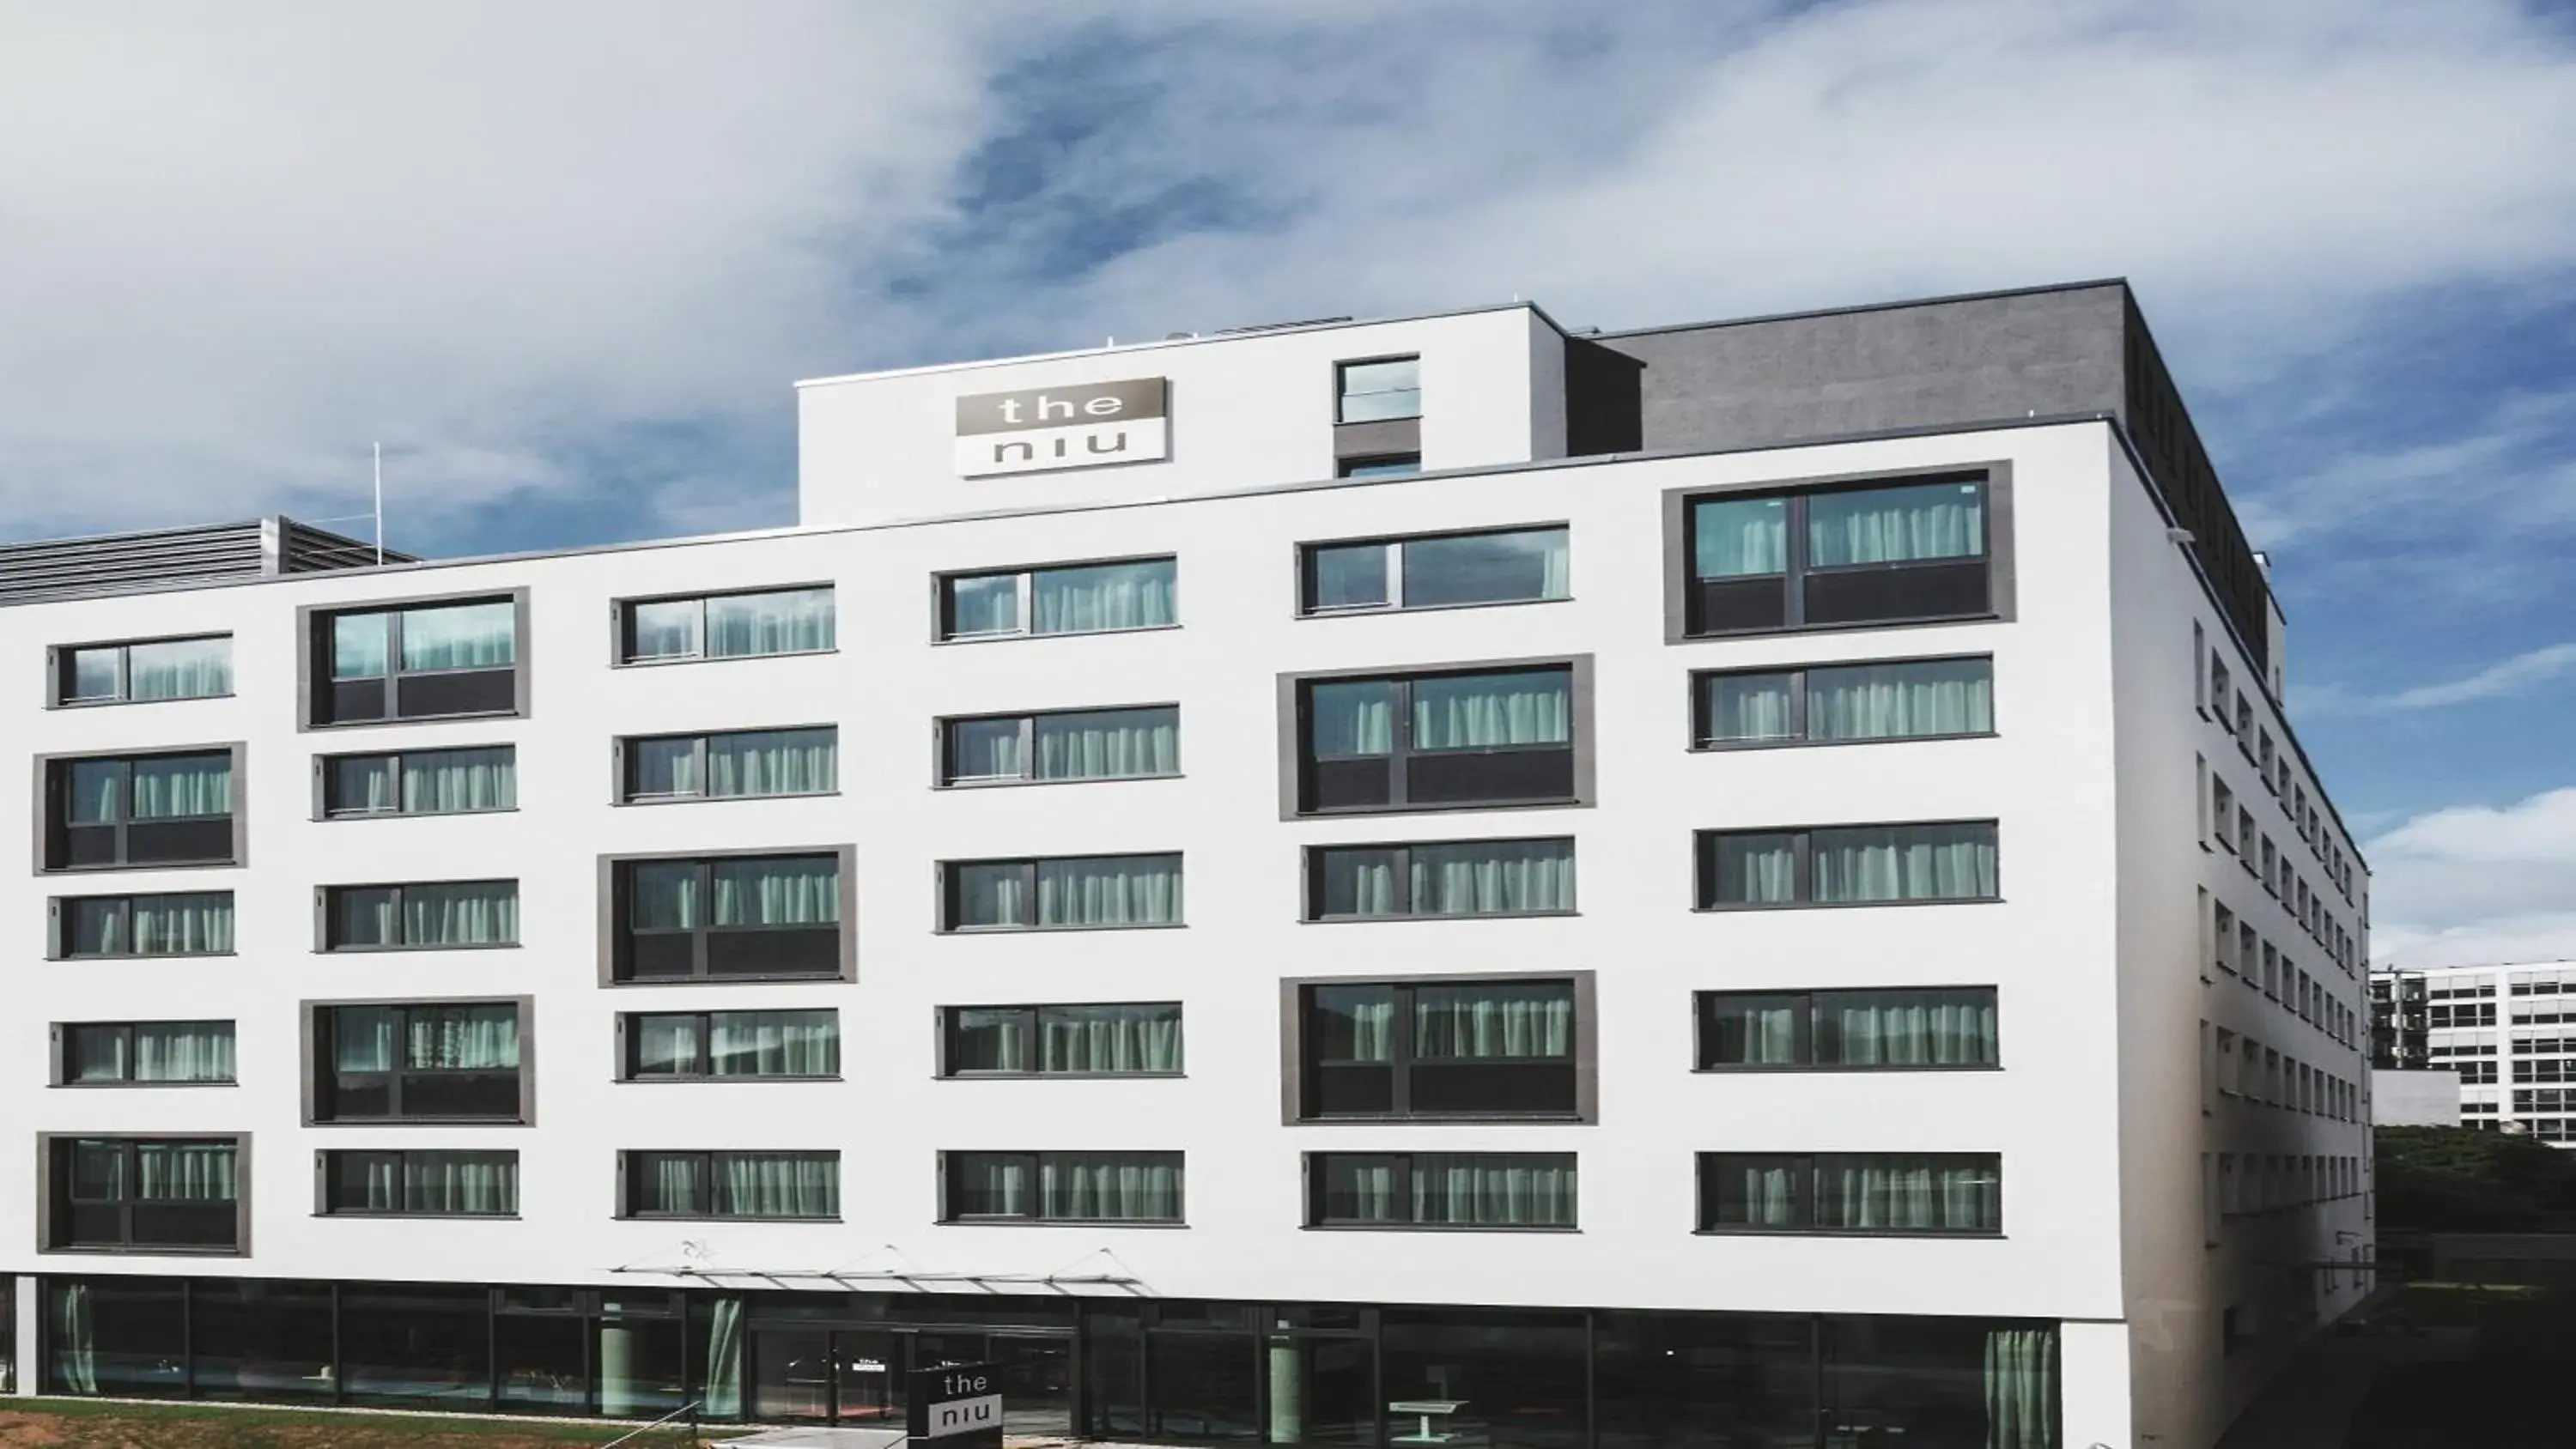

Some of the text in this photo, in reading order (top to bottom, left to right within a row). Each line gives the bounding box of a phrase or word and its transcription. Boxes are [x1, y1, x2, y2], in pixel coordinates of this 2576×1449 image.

[998, 395, 1122, 423] the
[994, 432, 1126, 462] niu
[945, 1373, 987, 1395] the
[943, 1404, 989, 1426] niu
